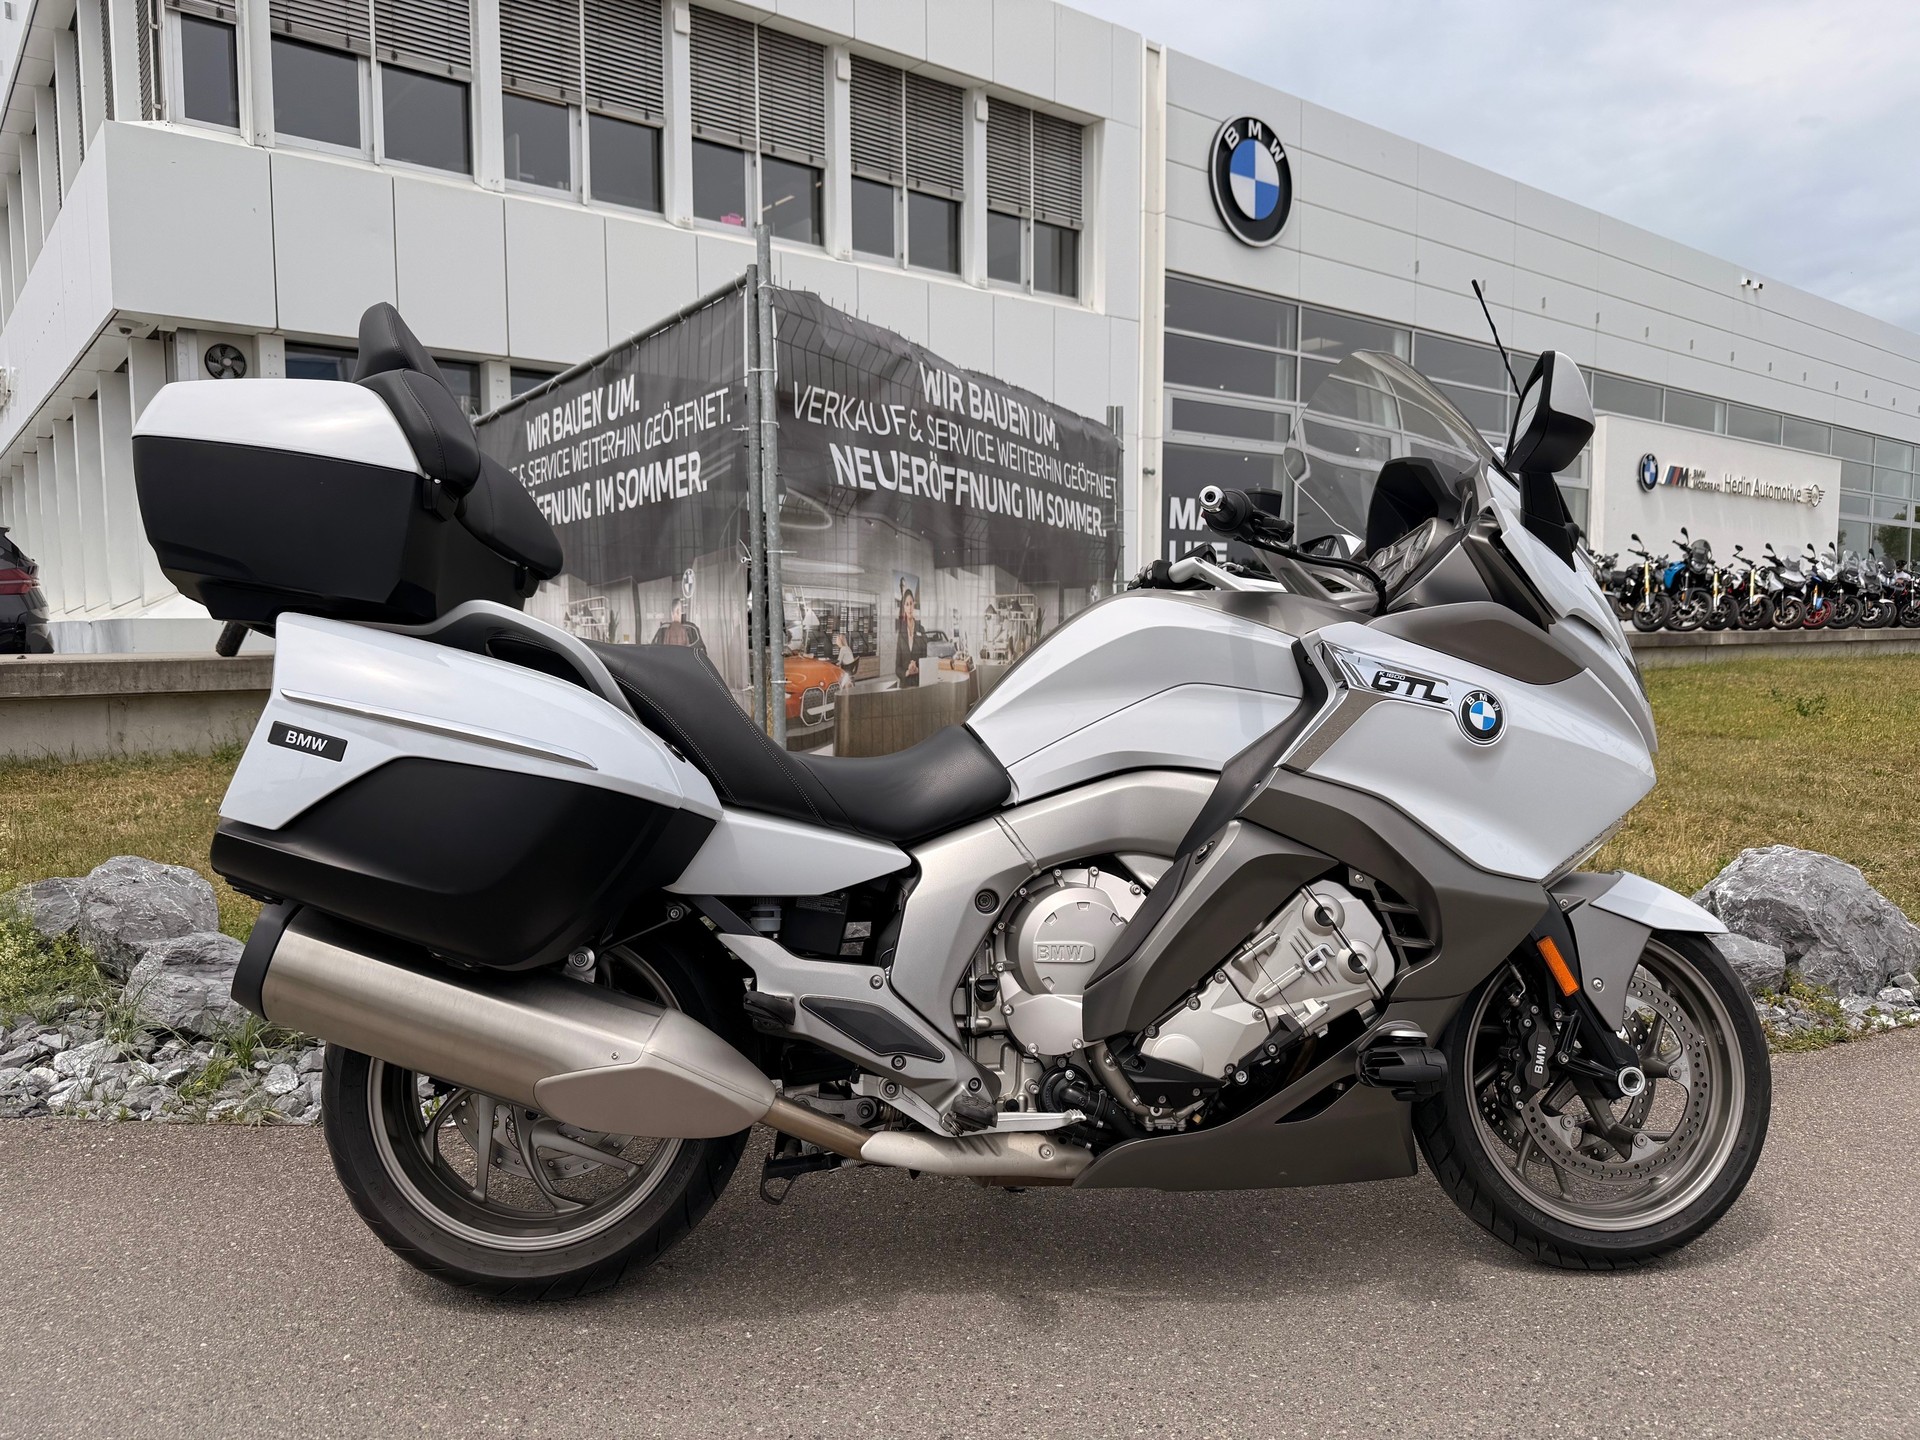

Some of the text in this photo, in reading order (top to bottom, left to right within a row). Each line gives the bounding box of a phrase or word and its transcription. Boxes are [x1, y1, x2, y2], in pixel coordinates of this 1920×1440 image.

[1224, 119, 1285, 163] BMW
[526, 374, 640, 452] WIR BAUEN UM.
[919, 361, 1060, 451] WIR BAUEN UM.
[528, 447, 570, 487] SERVICE
[571, 422, 641, 474] WEITERHIN
[644, 387, 731, 450] GEÖFFNET.
[793, 380, 906, 436] VERKAUF
[909, 408, 924, 443] &
[927, 414, 996, 464] SERVICE
[996, 437, 1063, 486] WEITERHIN
[595, 475, 616, 517] IM
[616, 450, 708, 512] SOMMER.
[828, 443, 1107, 537] NEUERÖFFNUNG IM SOMMER.
[1693, 469, 1706, 478] BMW
[1724, 473, 1802, 503] Hedin Automotive
[1371, 670, 1449, 703] GTL
[1466, 693, 1500, 711] BMW
[285, 730, 328, 752] BMW
[1037, 945, 1083, 961] BMW
[1534, 1044, 1547, 1074] BMW
